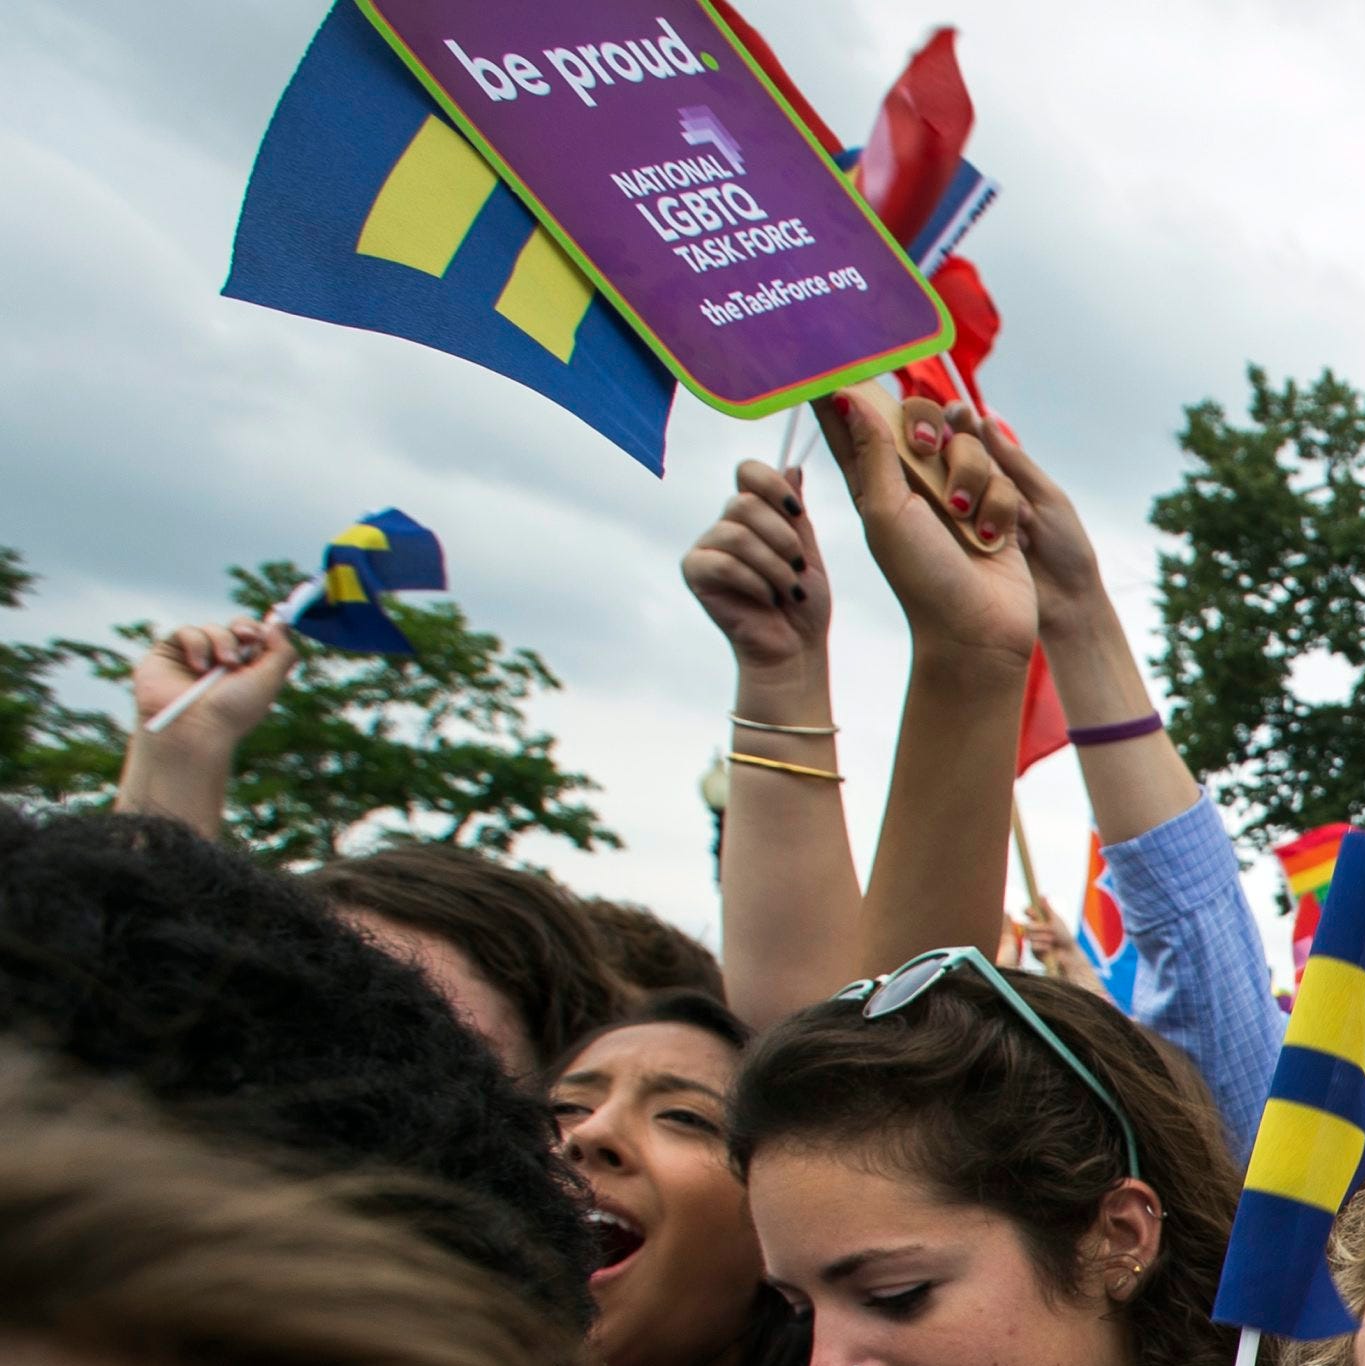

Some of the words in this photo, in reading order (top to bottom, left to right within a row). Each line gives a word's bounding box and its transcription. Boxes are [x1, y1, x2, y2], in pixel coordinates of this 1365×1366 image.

[443, 39, 550, 101] be
[542, 17, 720, 107] proud.
[610, 154, 734, 199] NATIONAL
[635, 182, 768, 242] LGBTQ
[672, 235, 748, 273] TASK
[734, 218, 816, 258] FORCE
